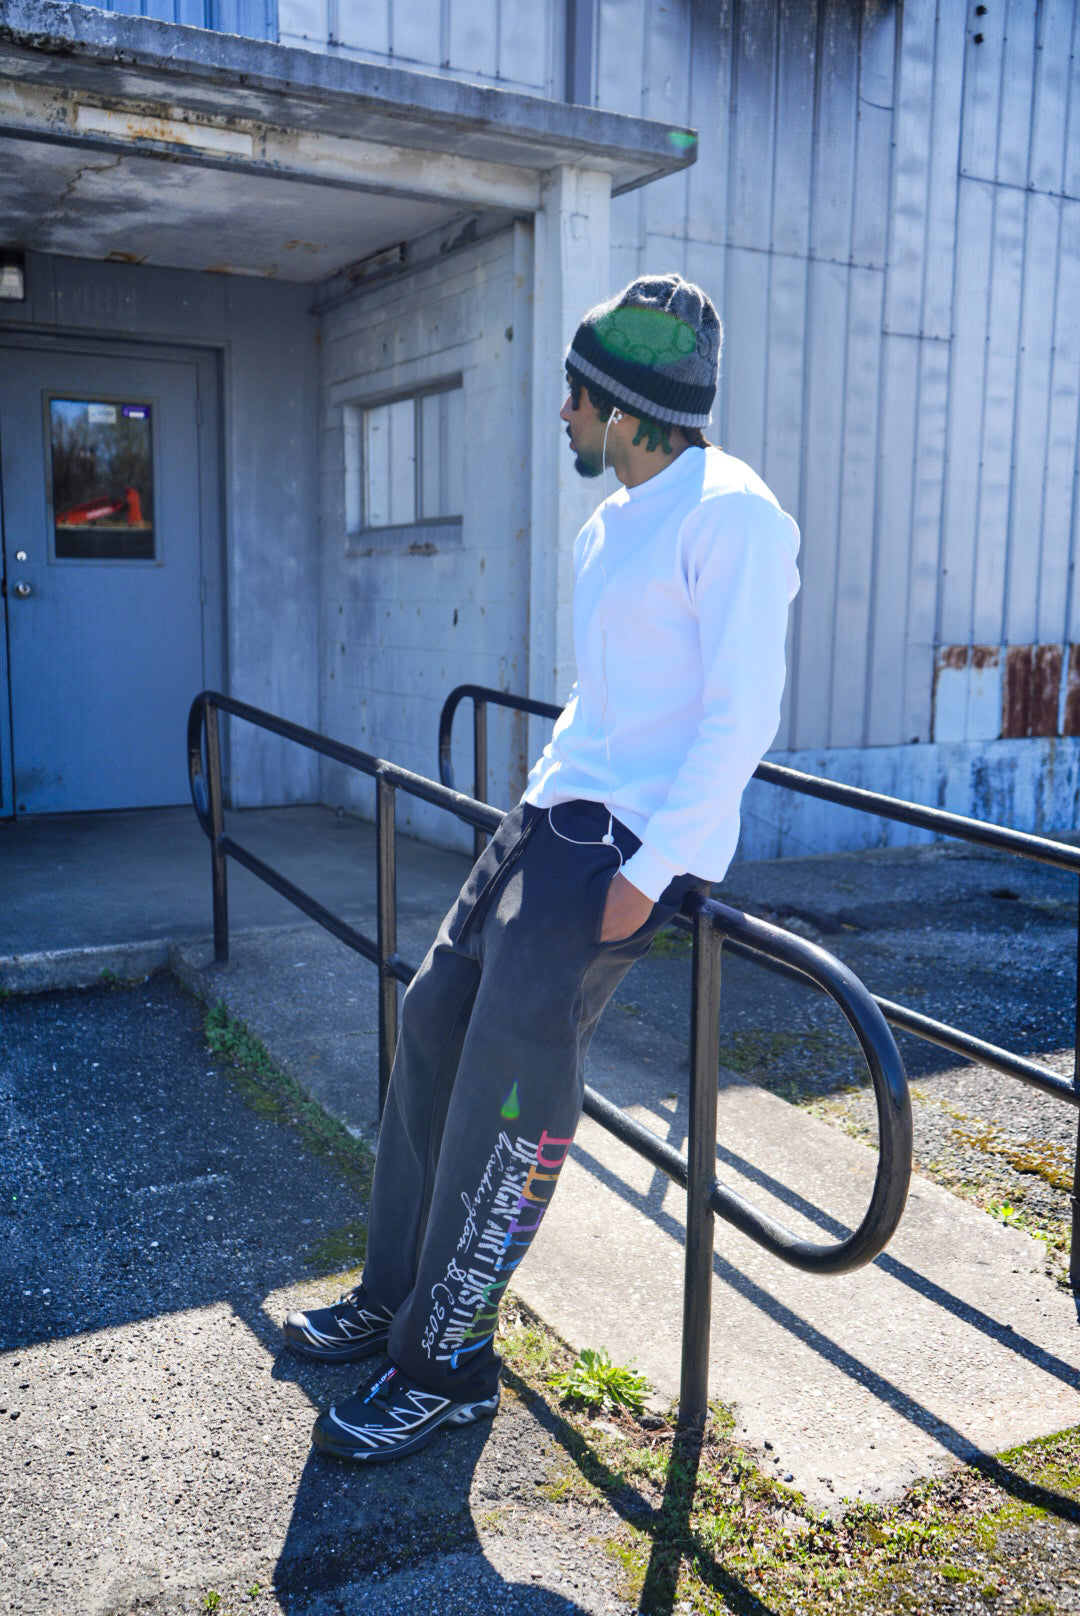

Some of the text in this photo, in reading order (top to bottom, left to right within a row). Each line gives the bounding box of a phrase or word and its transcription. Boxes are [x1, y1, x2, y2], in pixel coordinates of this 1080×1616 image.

[456, 1130, 514, 1254] Washington
[493, 1136, 539, 1221] DESIGN
[474, 1219, 512, 1272] ART
